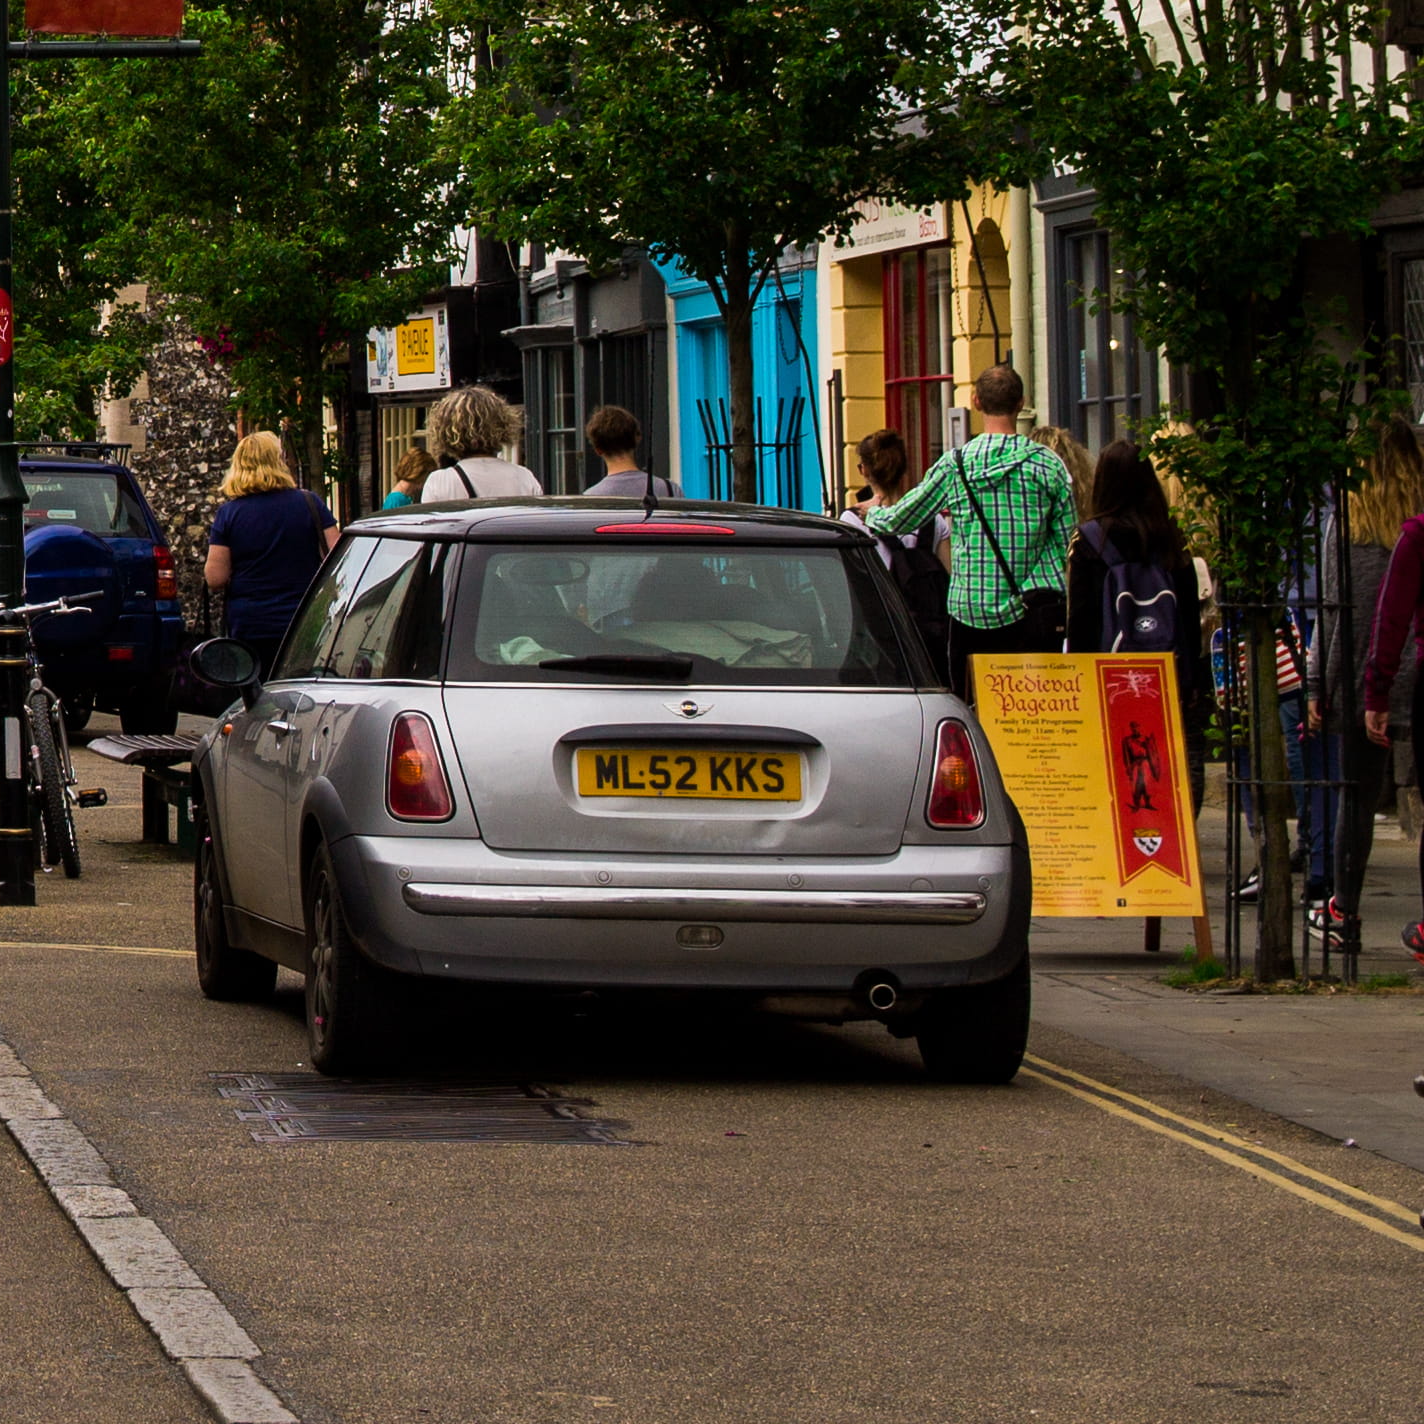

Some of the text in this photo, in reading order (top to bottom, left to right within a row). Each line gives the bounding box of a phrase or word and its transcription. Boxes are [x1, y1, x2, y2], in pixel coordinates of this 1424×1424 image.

[1049, 663, 1076, 671] Gallery
[983, 673, 1083, 693] Medieval
[993, 693, 1080, 717] Pageant
[709, 757, 785, 793] KKS
